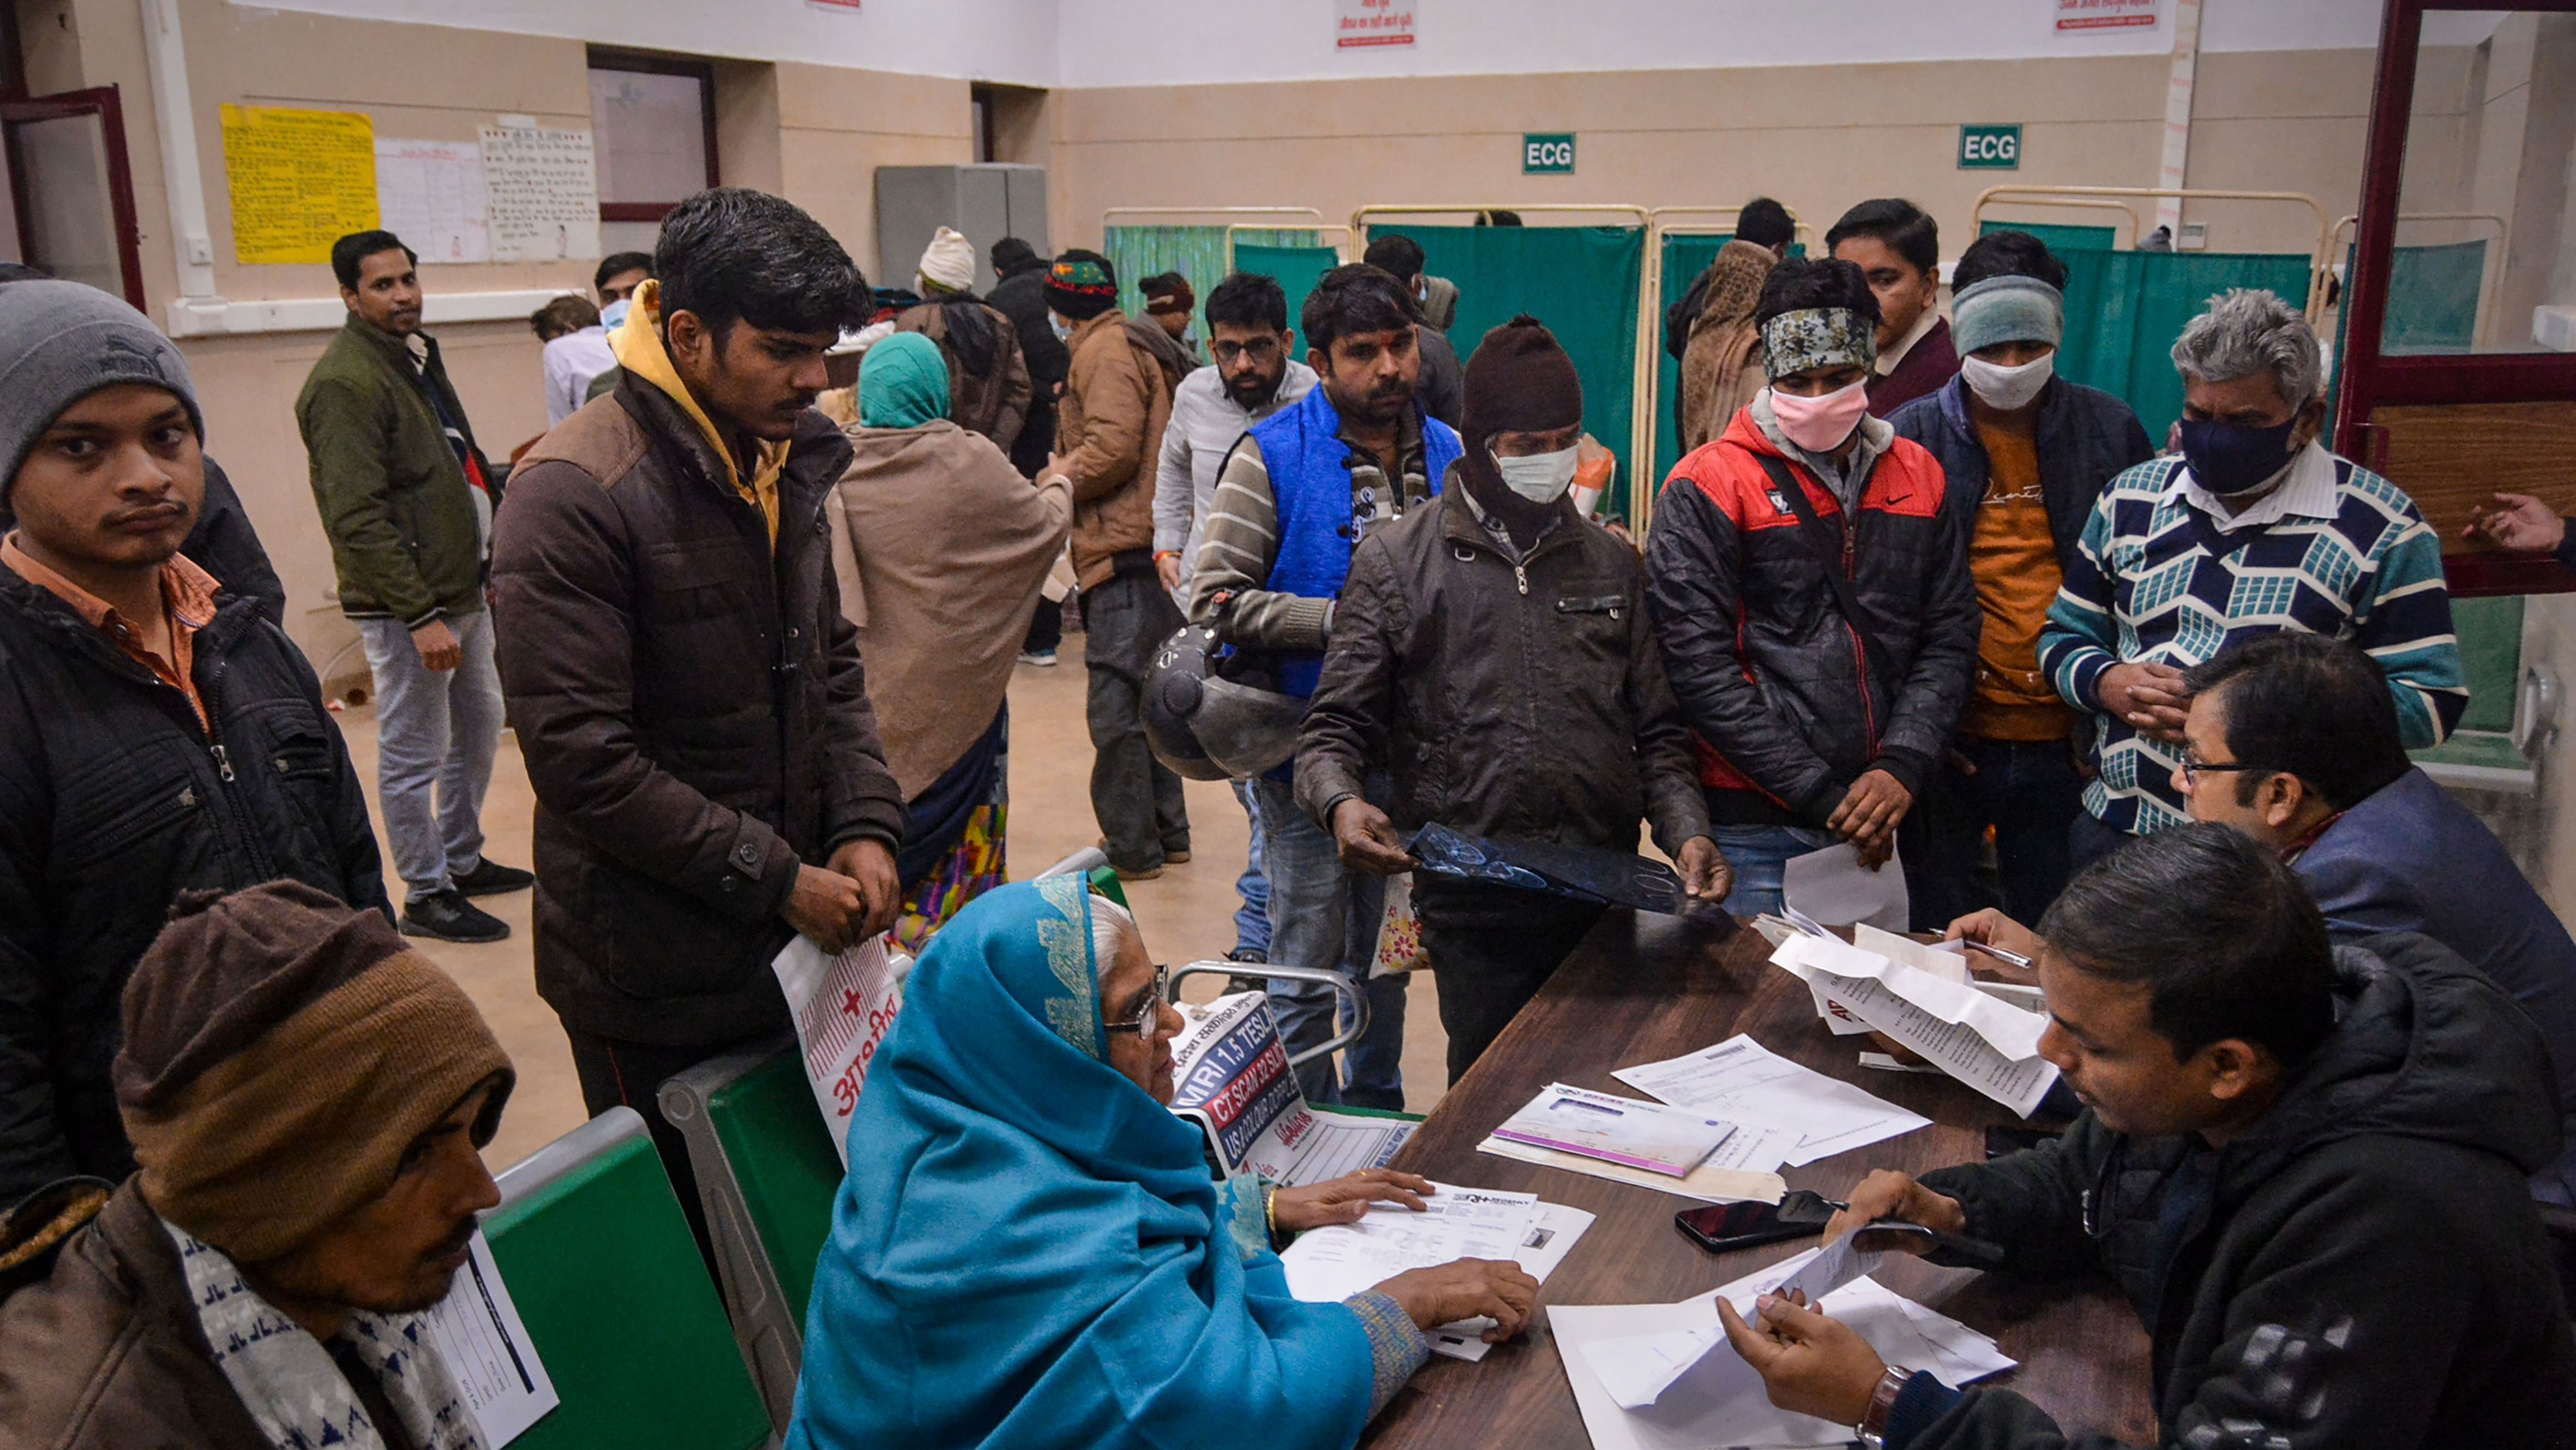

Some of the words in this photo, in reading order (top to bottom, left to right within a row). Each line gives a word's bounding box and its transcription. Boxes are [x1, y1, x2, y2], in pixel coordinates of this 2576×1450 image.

[1528, 142, 1571, 165] ECG
[1965, 134, 2015, 159] ECG
[1176, 1058, 1227, 1106] MRI
[1217, 1037, 1246, 1066] 1.5
[1212, 1093, 1234, 1122] CT
[1232, 1069, 1259, 1108] SCAN
[1257, 1059, 1269, 1083] 32
